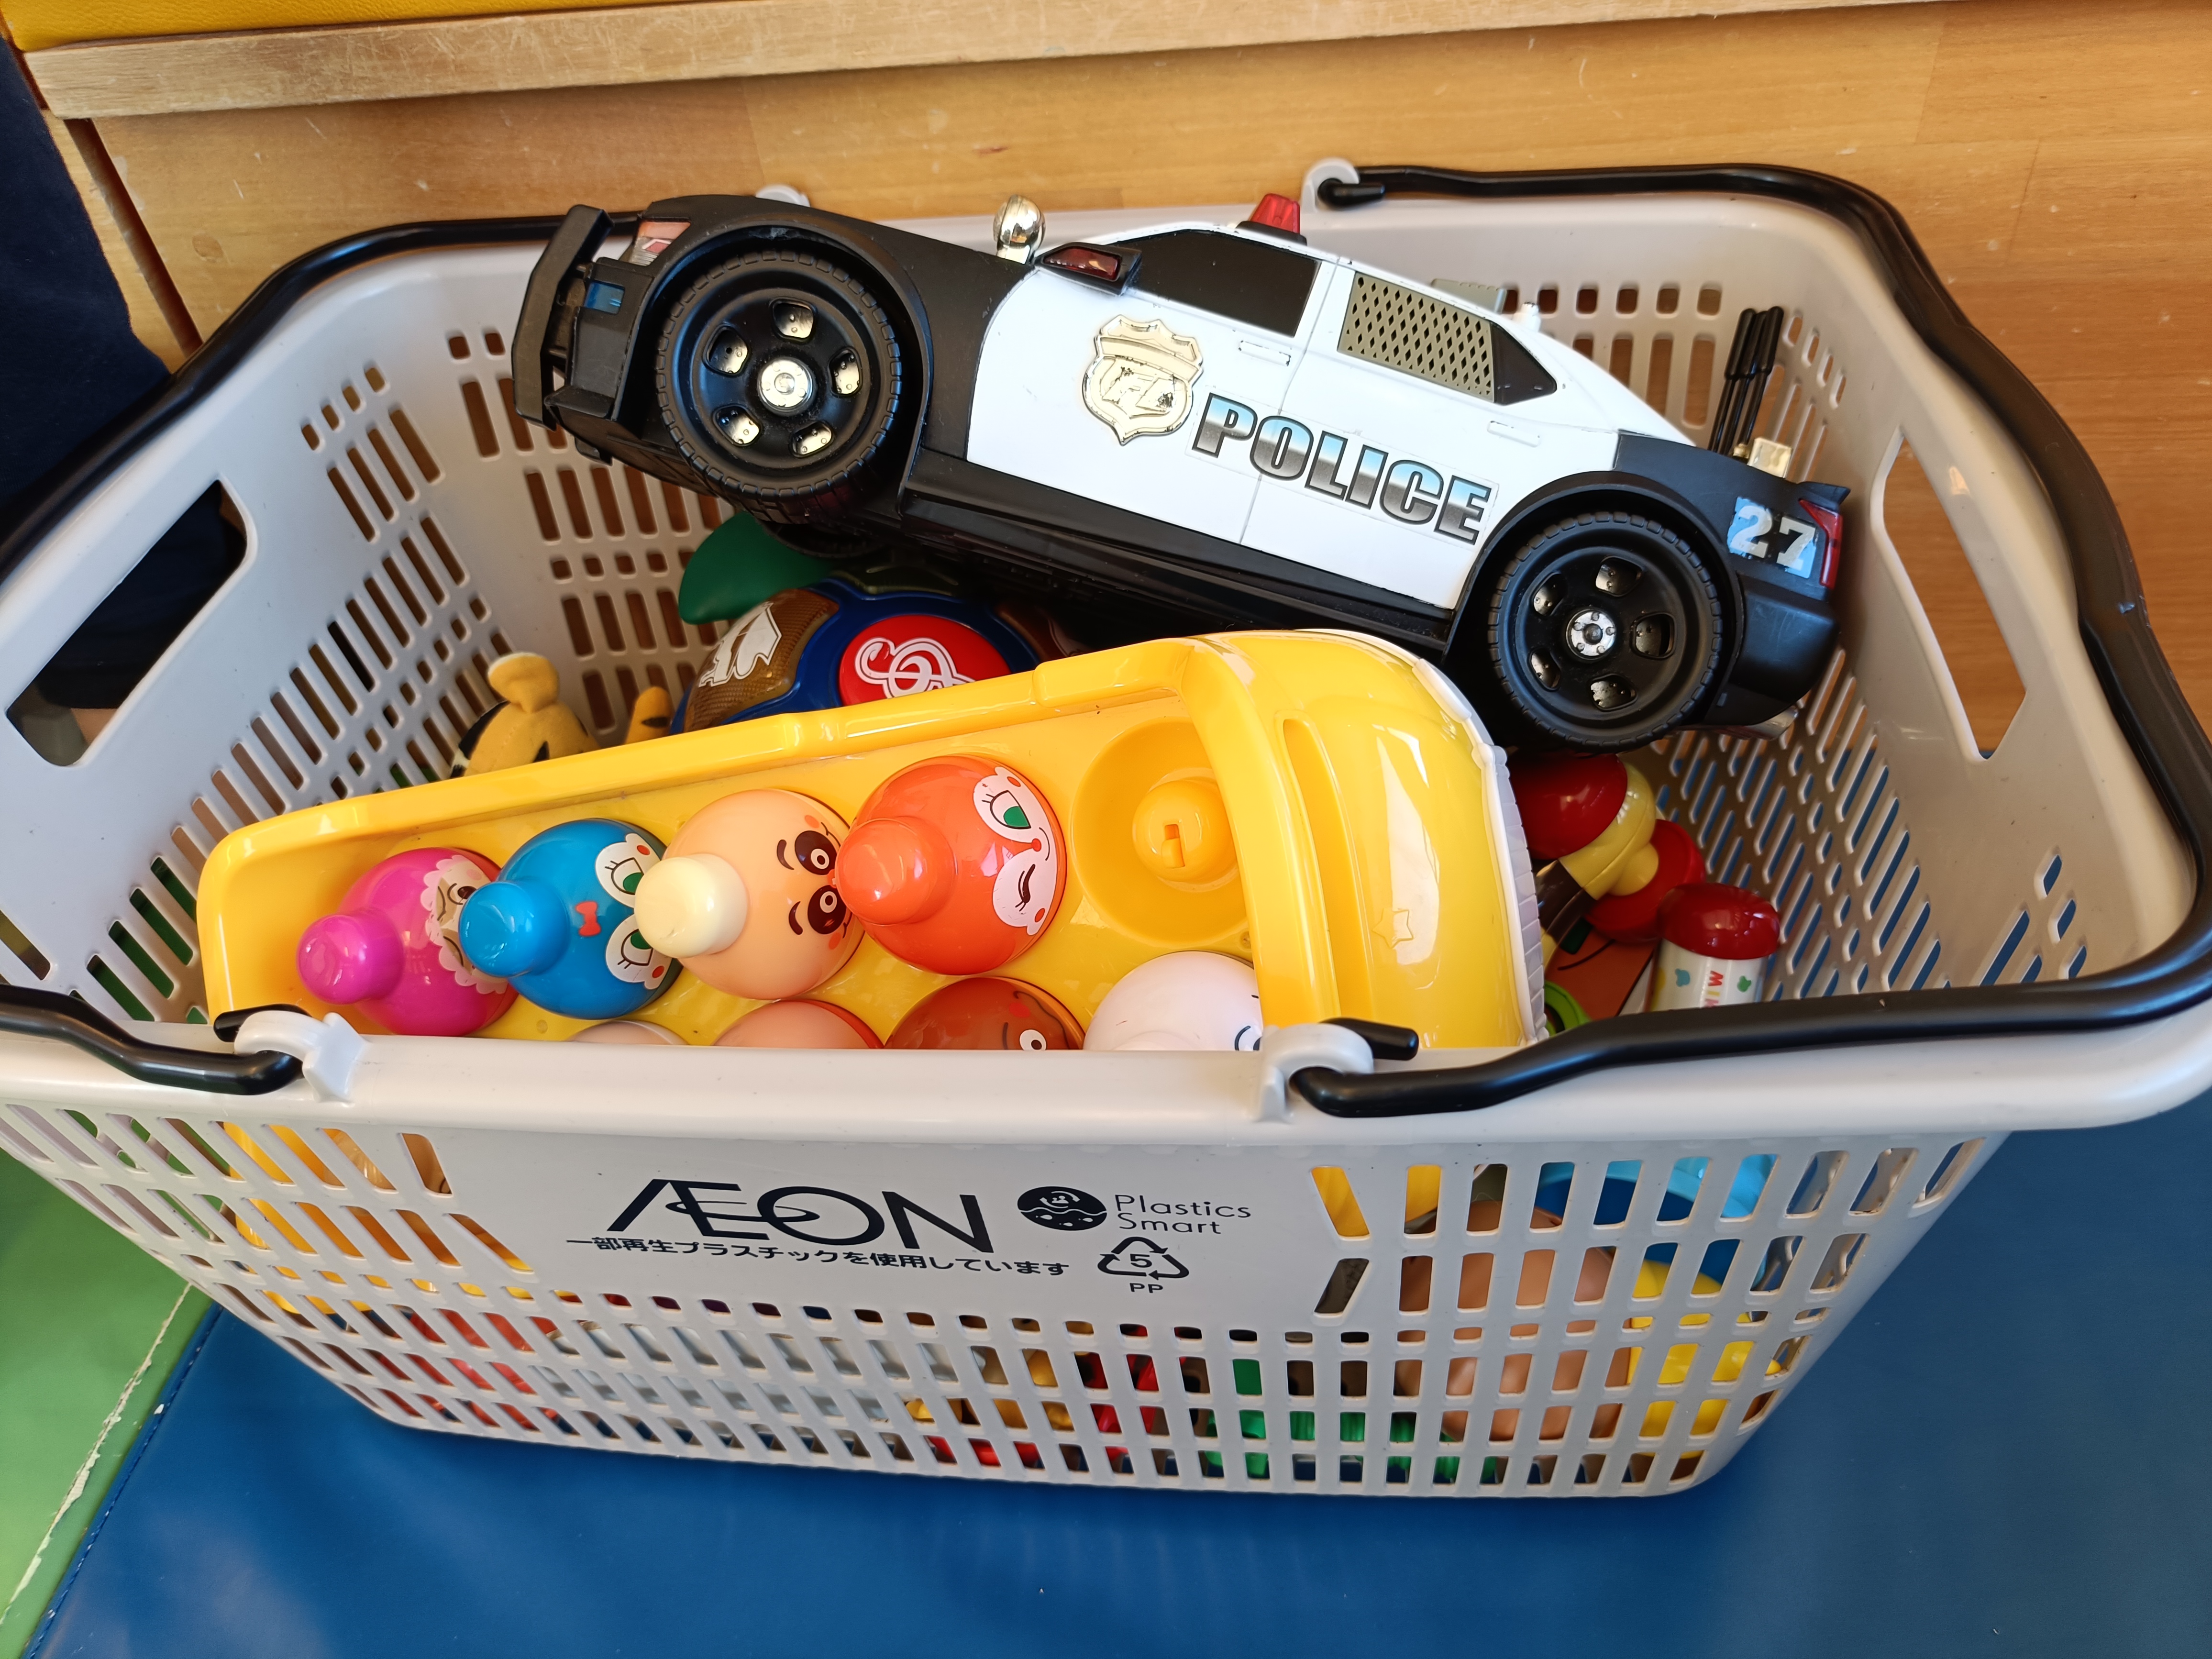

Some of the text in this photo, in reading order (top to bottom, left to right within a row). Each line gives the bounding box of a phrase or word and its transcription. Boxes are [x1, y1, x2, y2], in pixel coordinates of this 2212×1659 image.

[1191, 392, 1492, 545] POLICE
[1730, 505, 1816, 570] 27
[1115, 1194, 1251, 1218] Plastics
[1117, 1212, 1221, 1234] Smart
[566, 1237, 1069, 1275] 一部再生プラスチックを使用しています
[1130, 1253, 1152, 1268] 5
[1129, 1283, 1163, 1293] PP
